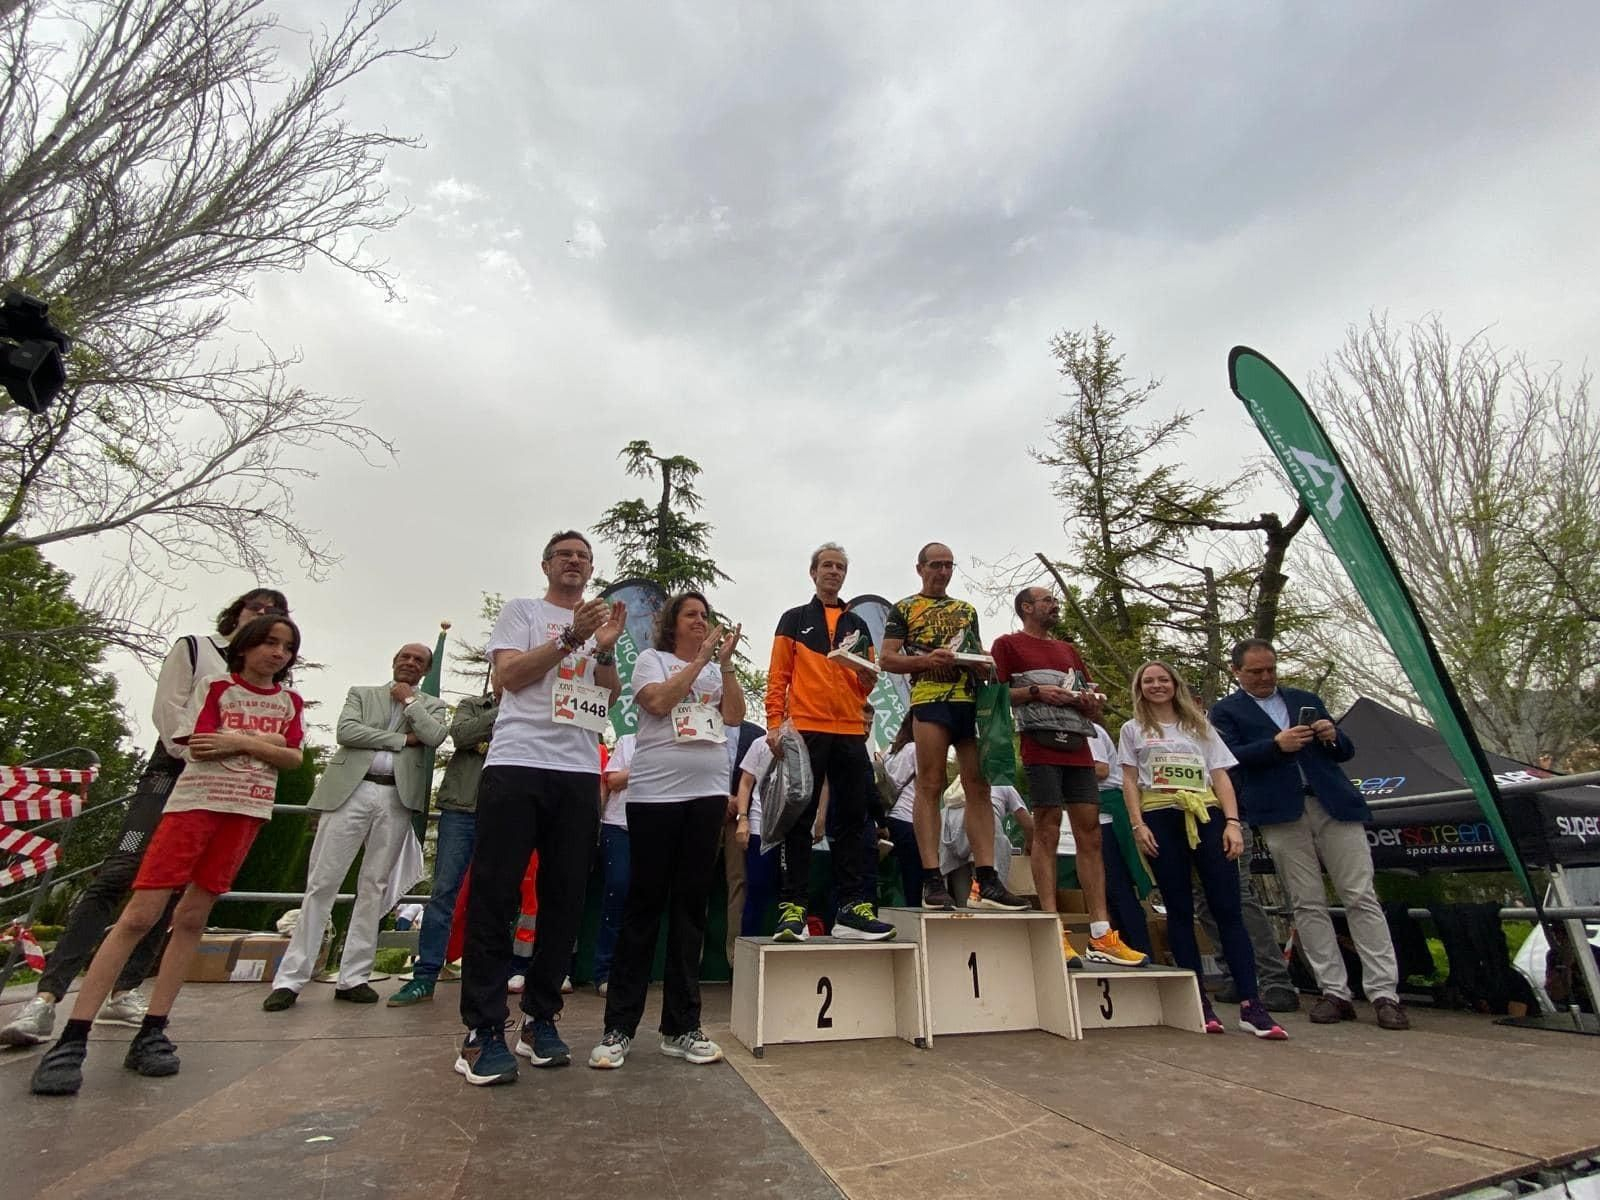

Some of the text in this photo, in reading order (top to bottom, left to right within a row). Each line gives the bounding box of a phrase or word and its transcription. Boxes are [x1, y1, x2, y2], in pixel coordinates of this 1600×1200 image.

[570, 697, 606, 718] 1448
[706, 718, 714, 729] 1
[1164, 766, 1204, 780] 5501
[1366, 823, 1495, 847] perscreen
[1556, 816, 1600, 843] super
[967, 952, 980, 998] 1
[816, 976, 833, 1028] 2
[1096, 977, 1114, 1020] 3
